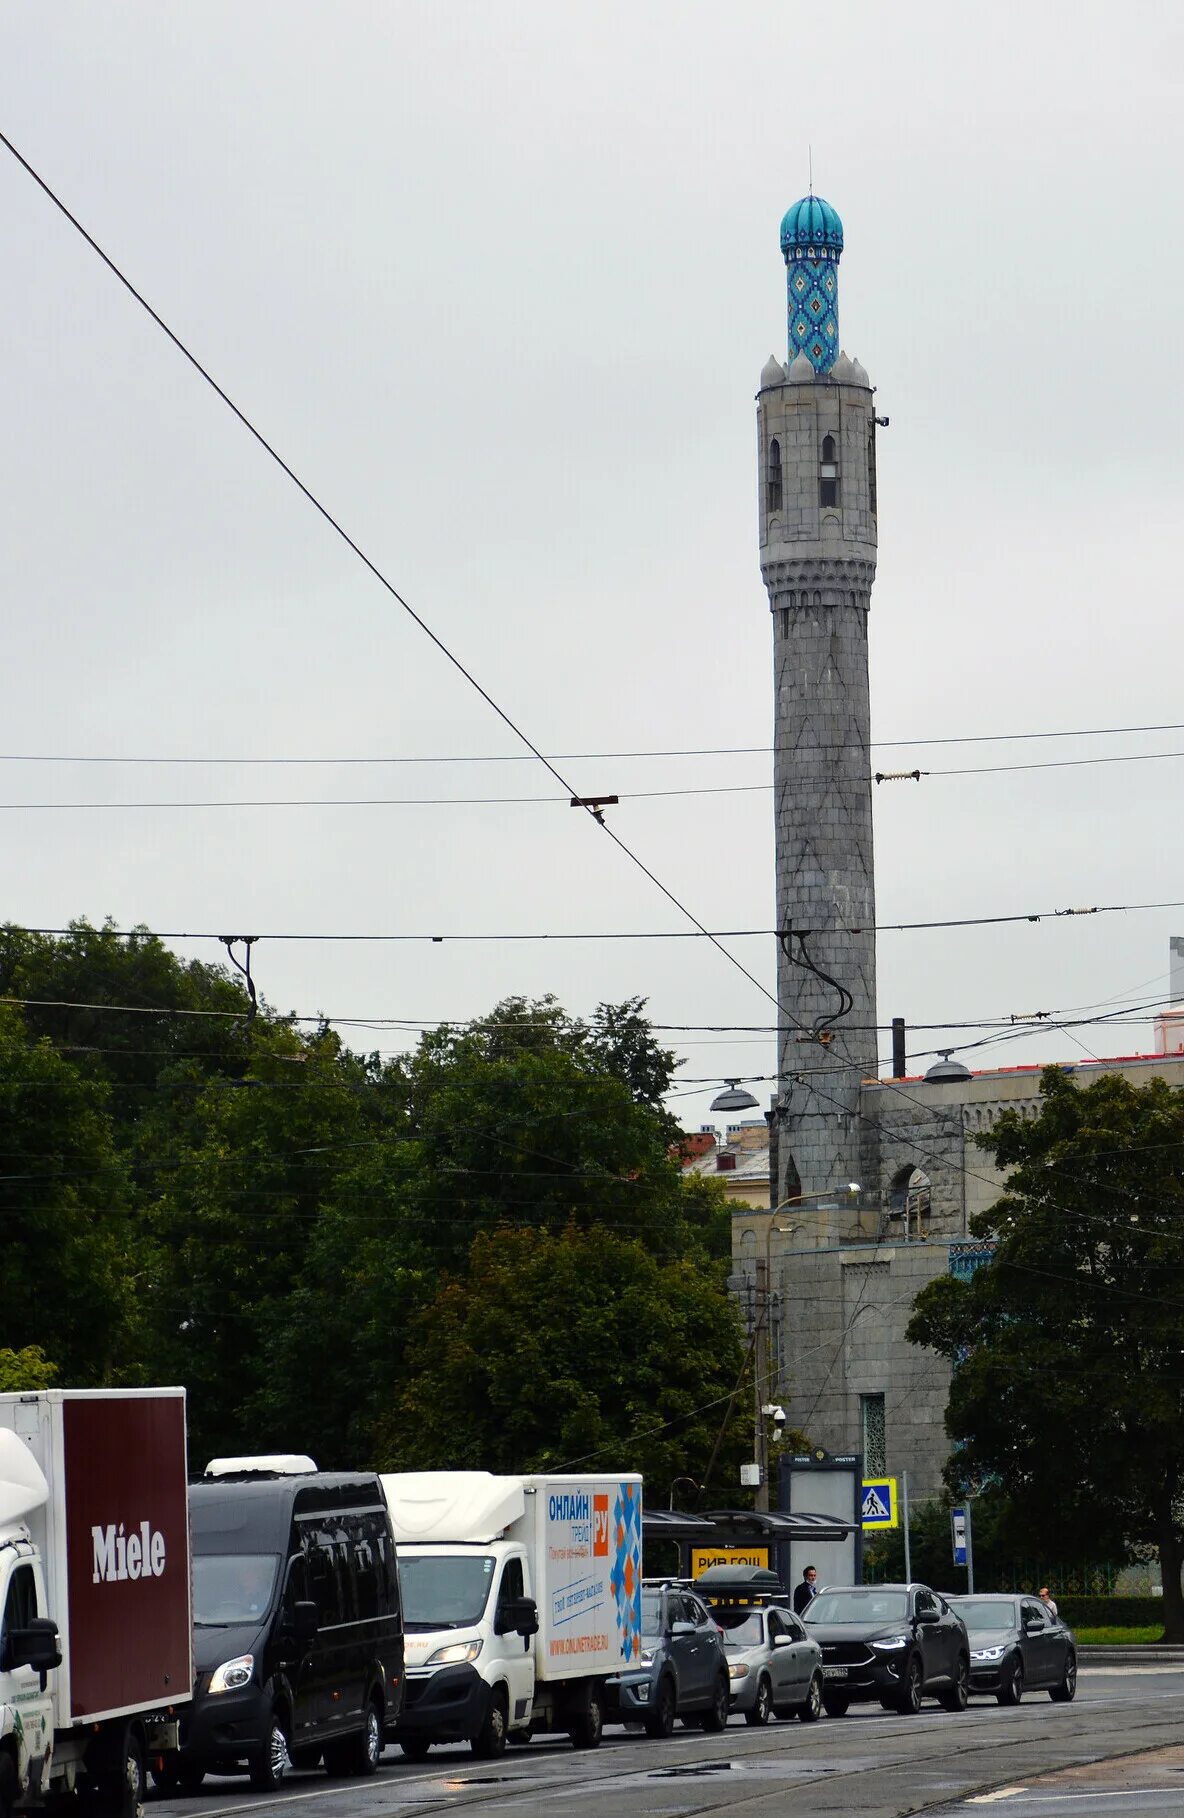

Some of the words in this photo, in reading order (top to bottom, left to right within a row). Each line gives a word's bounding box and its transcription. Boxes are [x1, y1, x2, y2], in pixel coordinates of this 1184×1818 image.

[549, 1489, 589, 1521] ОНЛАЙН
[571, 1523, 589, 1543] ТРЕЙД
[594, 1510, 608, 1543] РУ
[91, 1520, 166, 1584] Miele
[698, 1557, 727, 1568] РИВ
[730, 1557, 760, 1567] ГОШ
[549, 1634, 609, 1657] WWW.ONLINETRADE.RU
